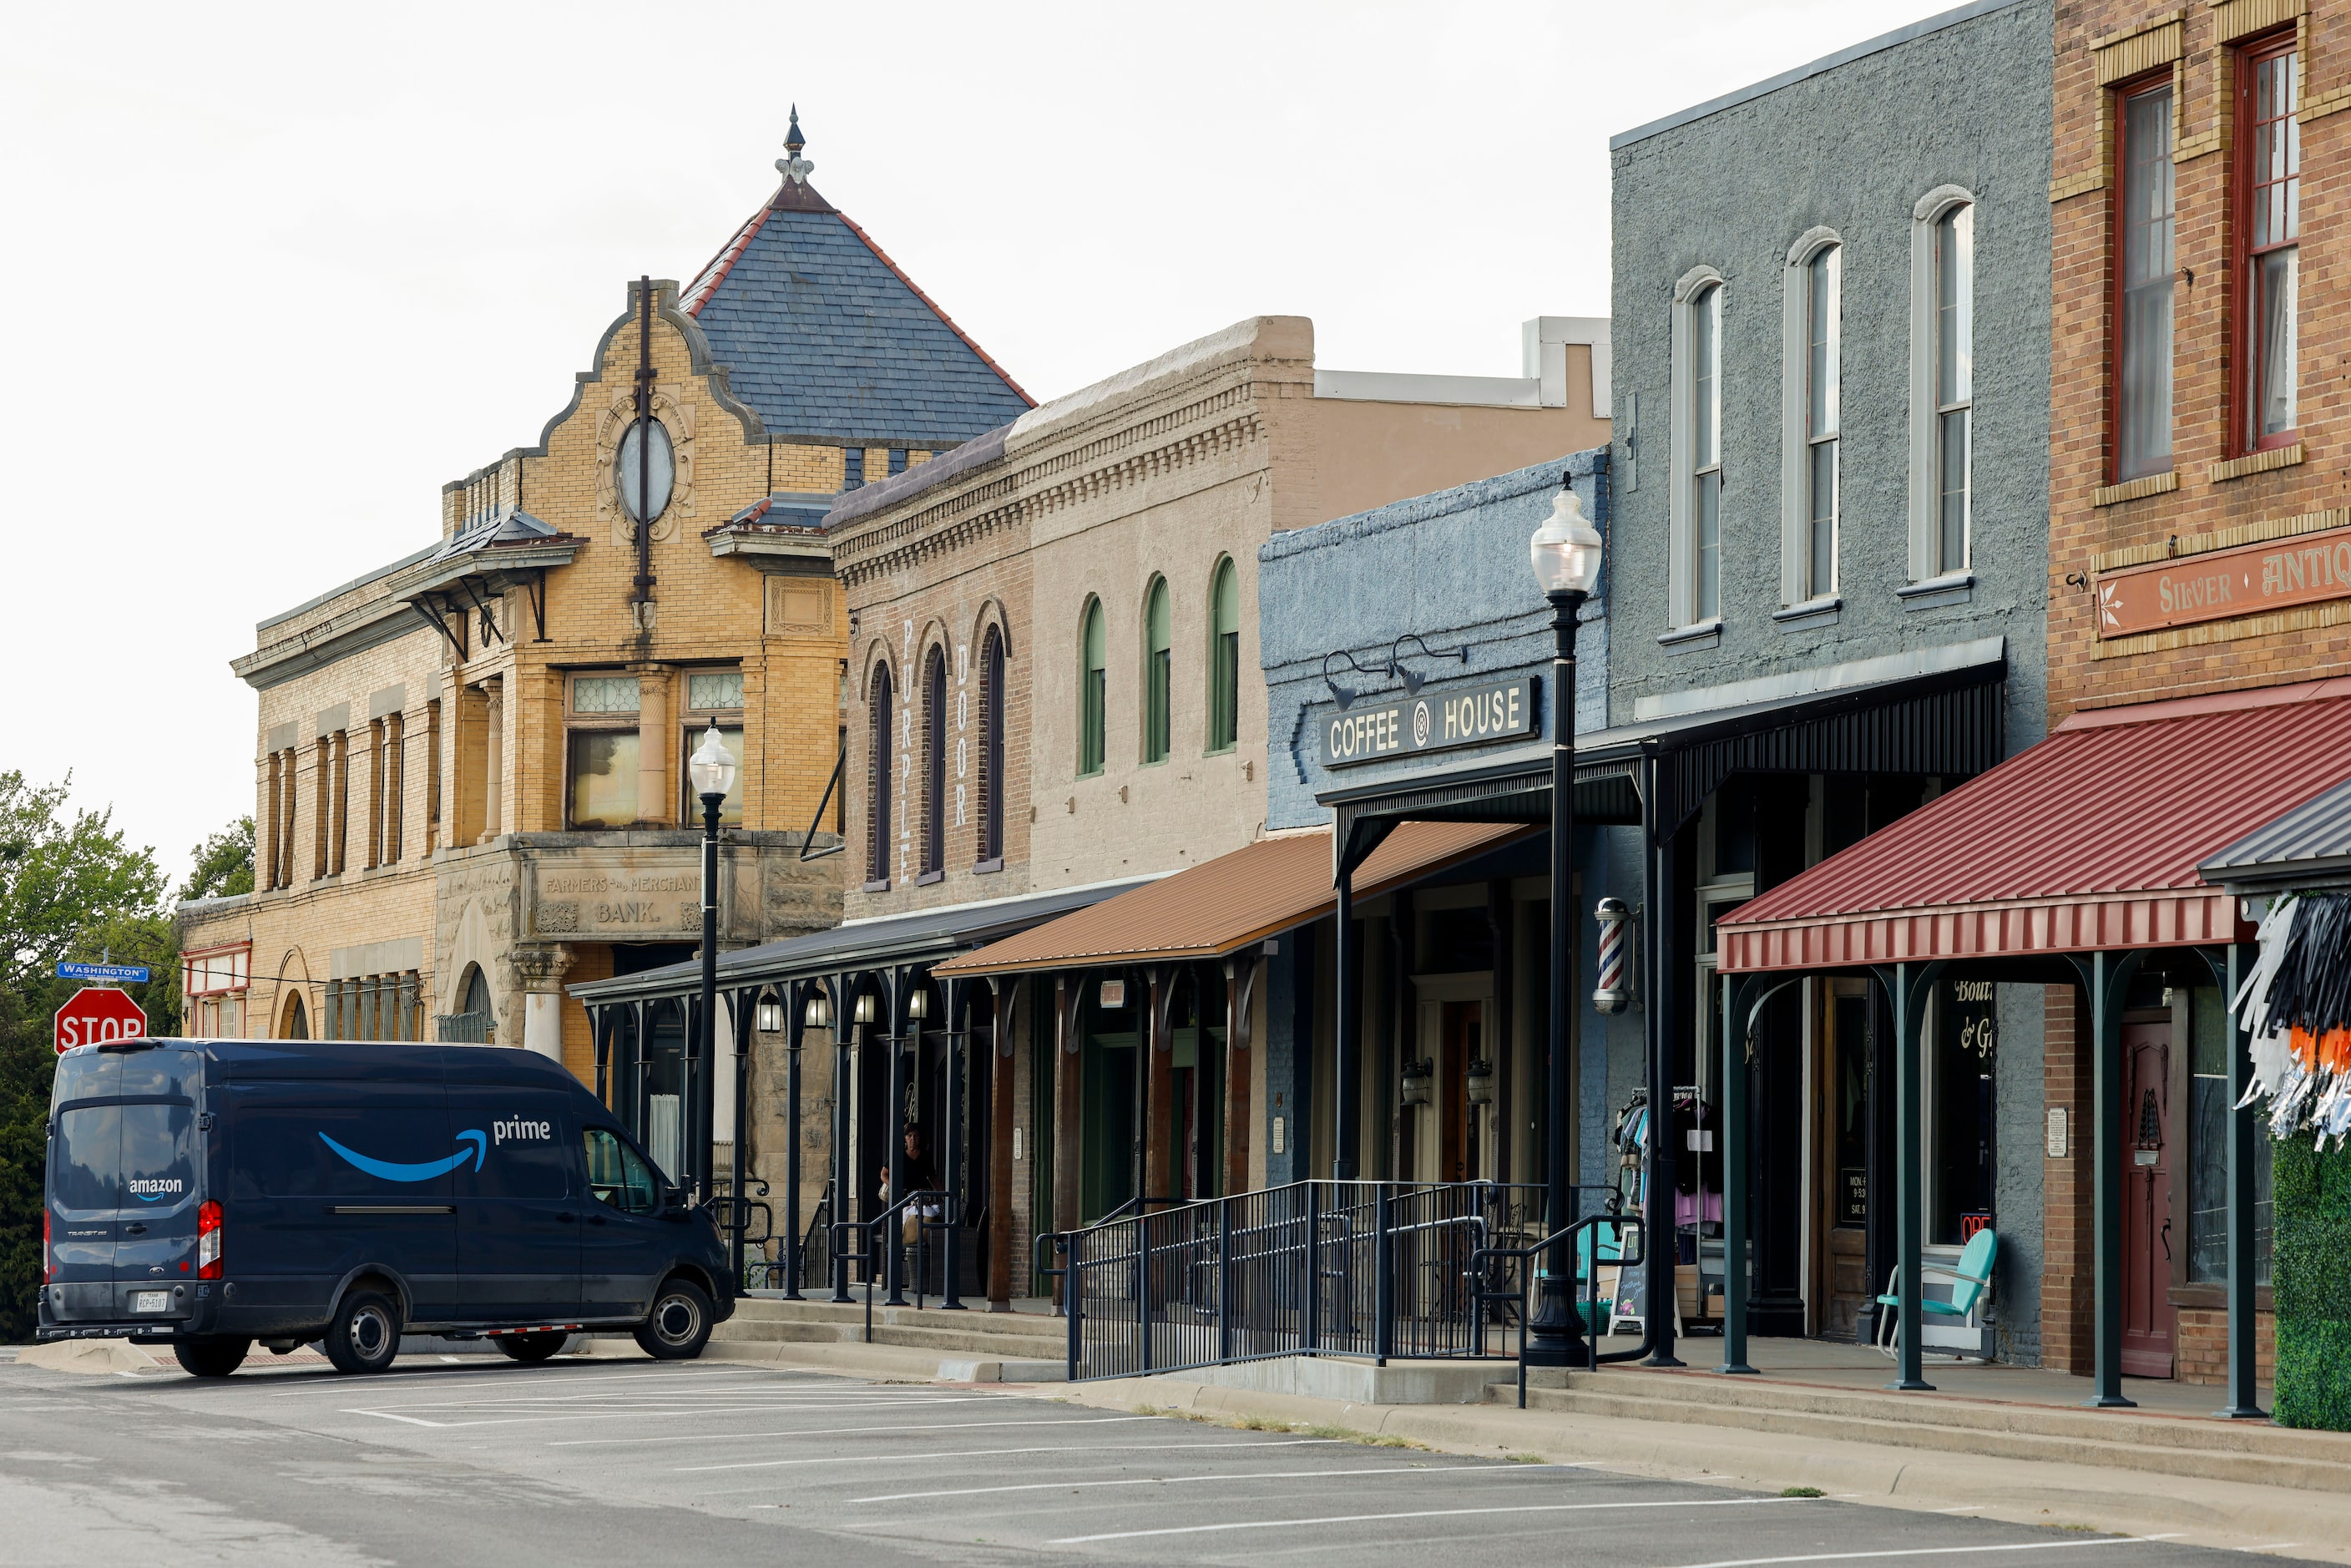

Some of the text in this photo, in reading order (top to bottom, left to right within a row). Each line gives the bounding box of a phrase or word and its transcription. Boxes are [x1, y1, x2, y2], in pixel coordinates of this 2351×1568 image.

[2159, 574, 2232, 614] SILVER
[955, 644, 969, 827] DOOR
[1330, 686, 1520, 759] COFFEE HOUSE
[899, 620, 913, 884] PURPLE
[544, 878, 608, 893] FARMERS
[63, 964, 139, 977] WASHINGTON
[60, 1016, 142, 1049] STOP
[493, 1114, 551, 1146] prime
[129, 1179, 182, 1193] amazon
